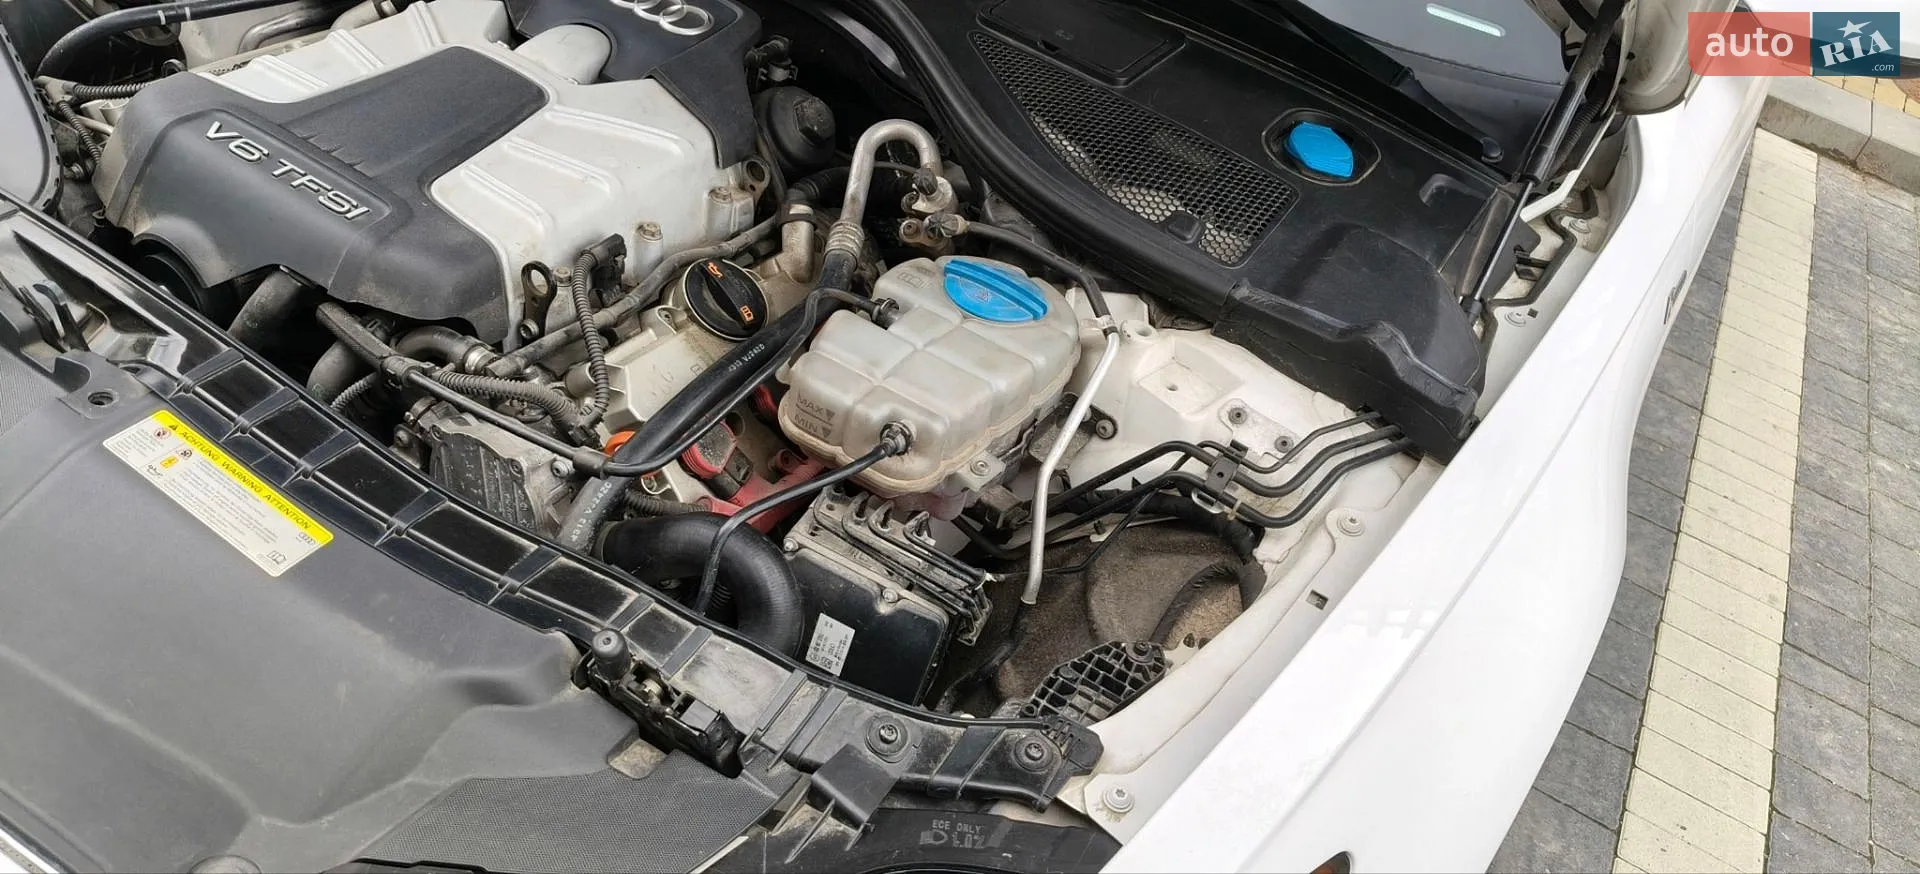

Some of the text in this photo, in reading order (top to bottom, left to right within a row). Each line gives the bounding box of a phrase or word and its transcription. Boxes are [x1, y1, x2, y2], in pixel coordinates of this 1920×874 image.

[206, 120, 370, 220] V6 TFSI
[797, 390, 824, 414] MAX
[795, 413, 817, 433] MIN
[180, 430, 220, 461] ACHTUNG
[221, 461, 262, 493] WARNING
[263, 493, 311, 529] ATTENTION
[932, 819, 982, 833] ECE ONLY
